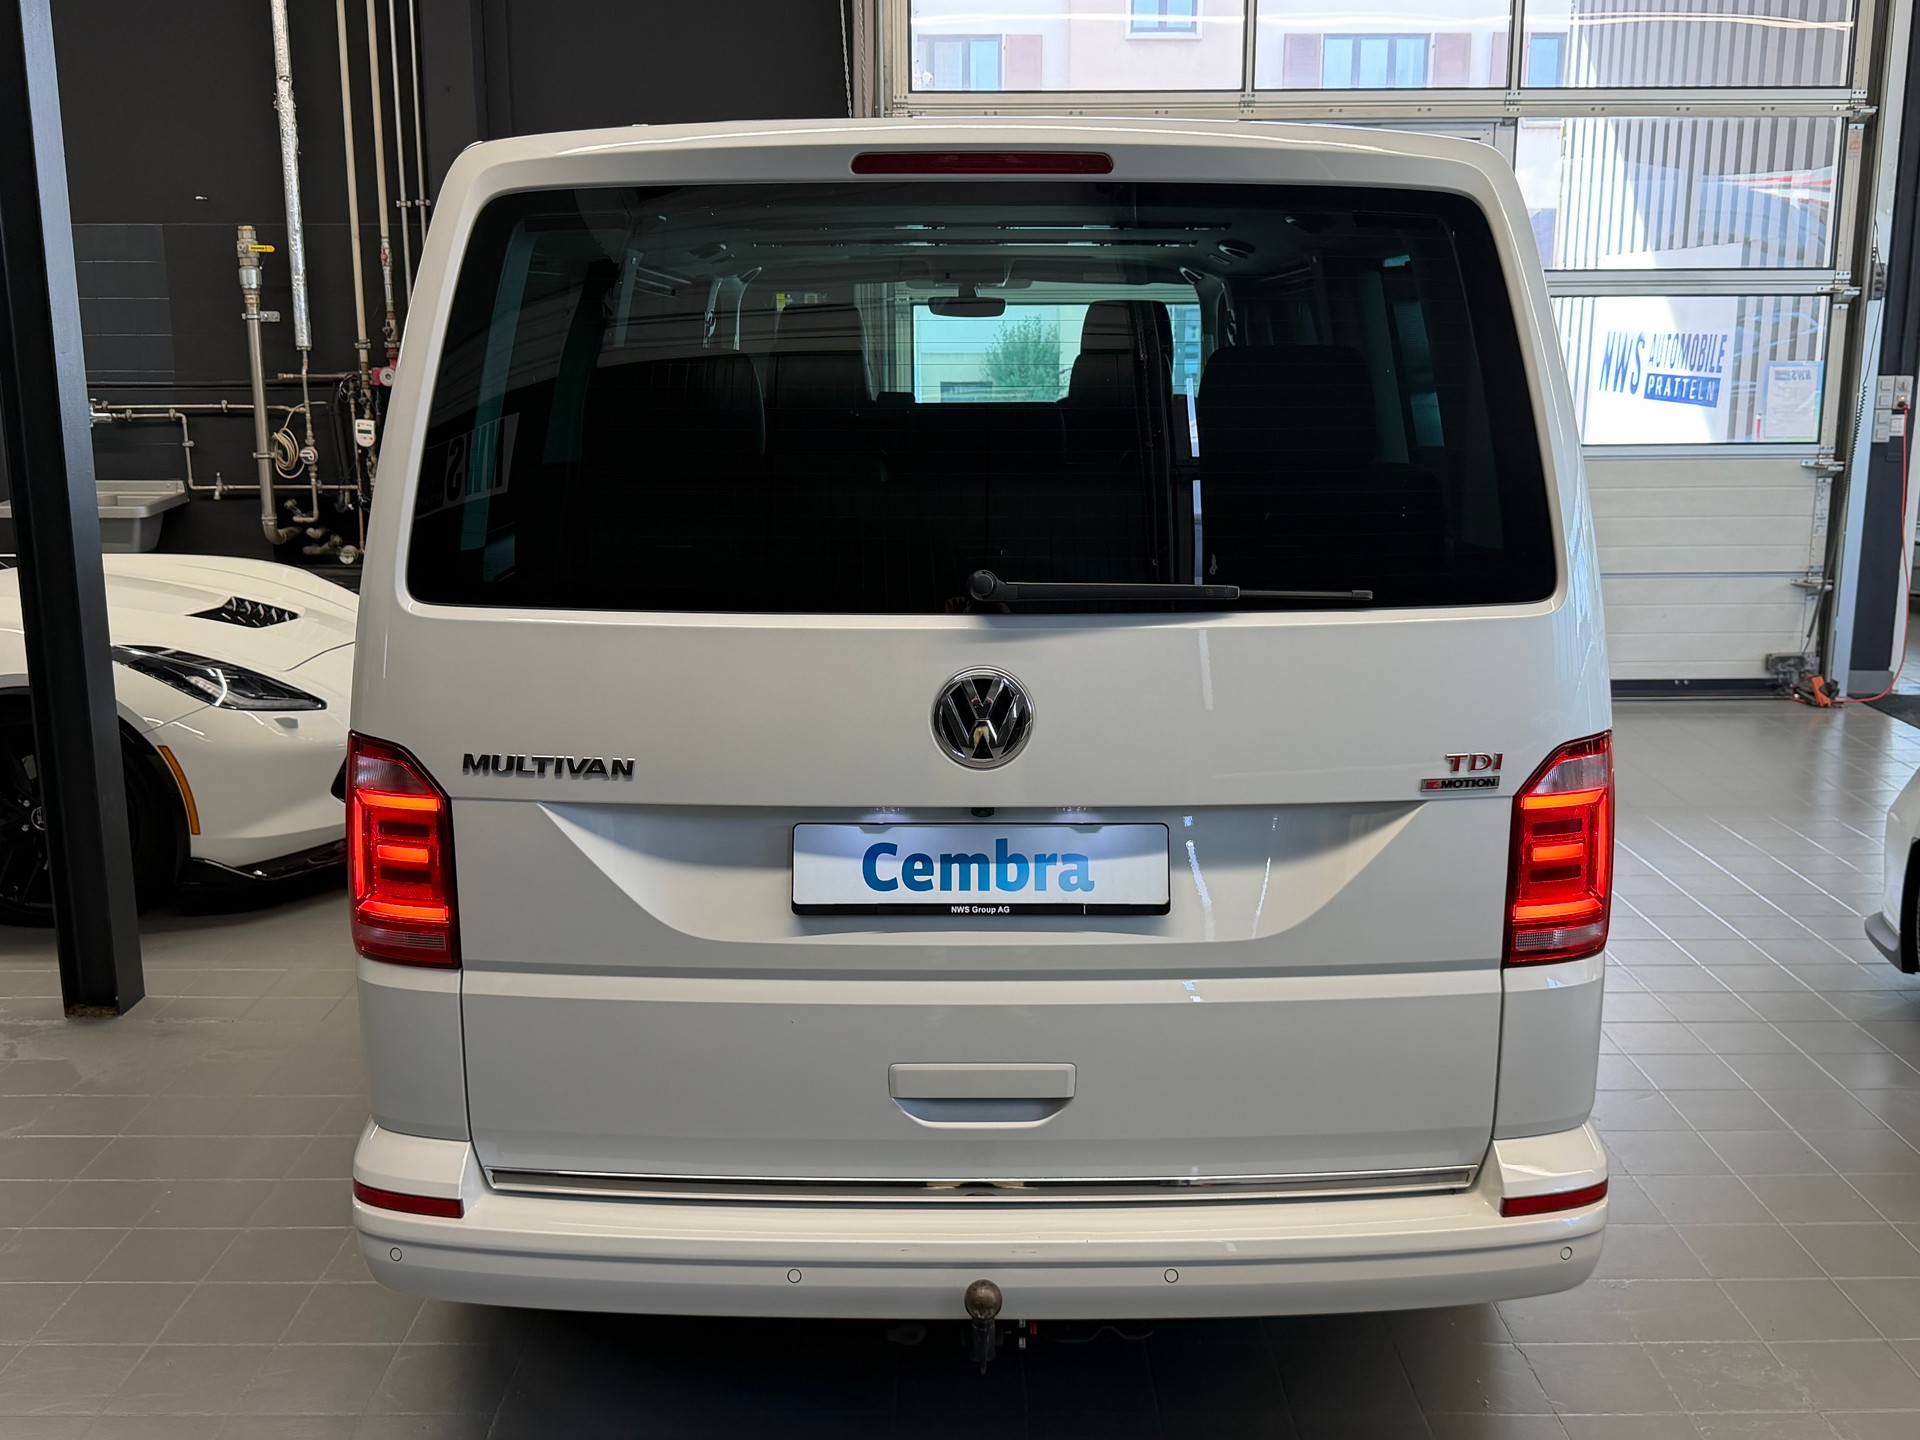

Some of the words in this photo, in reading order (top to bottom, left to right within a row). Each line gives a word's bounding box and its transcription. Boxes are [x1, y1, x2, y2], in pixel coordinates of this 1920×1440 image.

[1598, 331, 1646, 395] NWS
[1647, 333, 1727, 374] AUTOMOBILE
[1647, 374, 1716, 402] PRATTELN
[462, 753, 636, 780] MULTIVAN
[1445, 752, 1503, 772] TDI
[861, 838, 1095, 893] Cembra
[951, 905, 970, 914] NWS
[971, 905, 997, 915] Group
[997, 905, 1010, 914] AG
